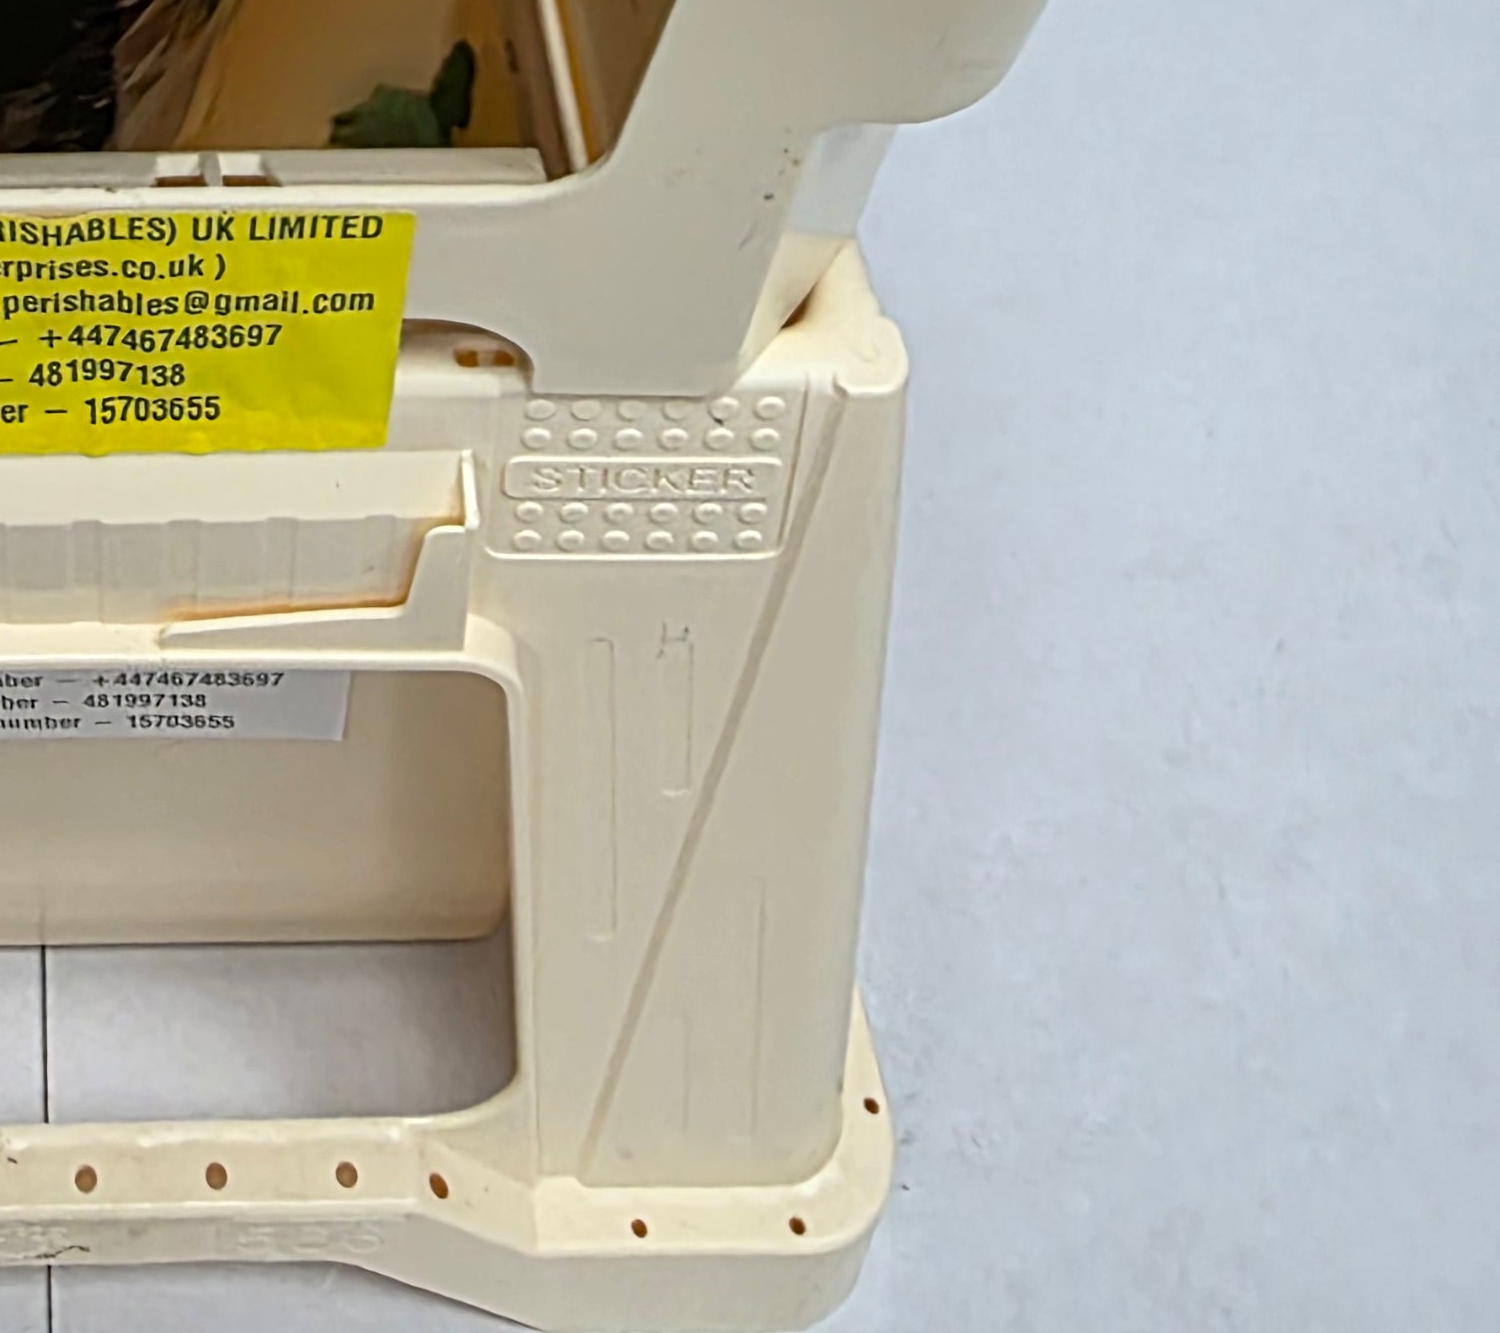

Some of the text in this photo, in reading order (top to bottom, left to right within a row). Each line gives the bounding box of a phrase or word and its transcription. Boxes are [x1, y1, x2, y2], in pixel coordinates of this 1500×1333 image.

[192, 215, 235, 242] UK
[249, 215, 383, 241] LIMITED
[39, 324, 283, 353] +447467483697
[29, 358, 186, 387] 481997138
[84, 395, 221, 425] 15703655
[531, 466, 755, 496] STICKER
[92, 671, 285, 687] +447467483697
[83, 693, 207, 708] 481997138
[127, 714, 235, 729] 15703655
